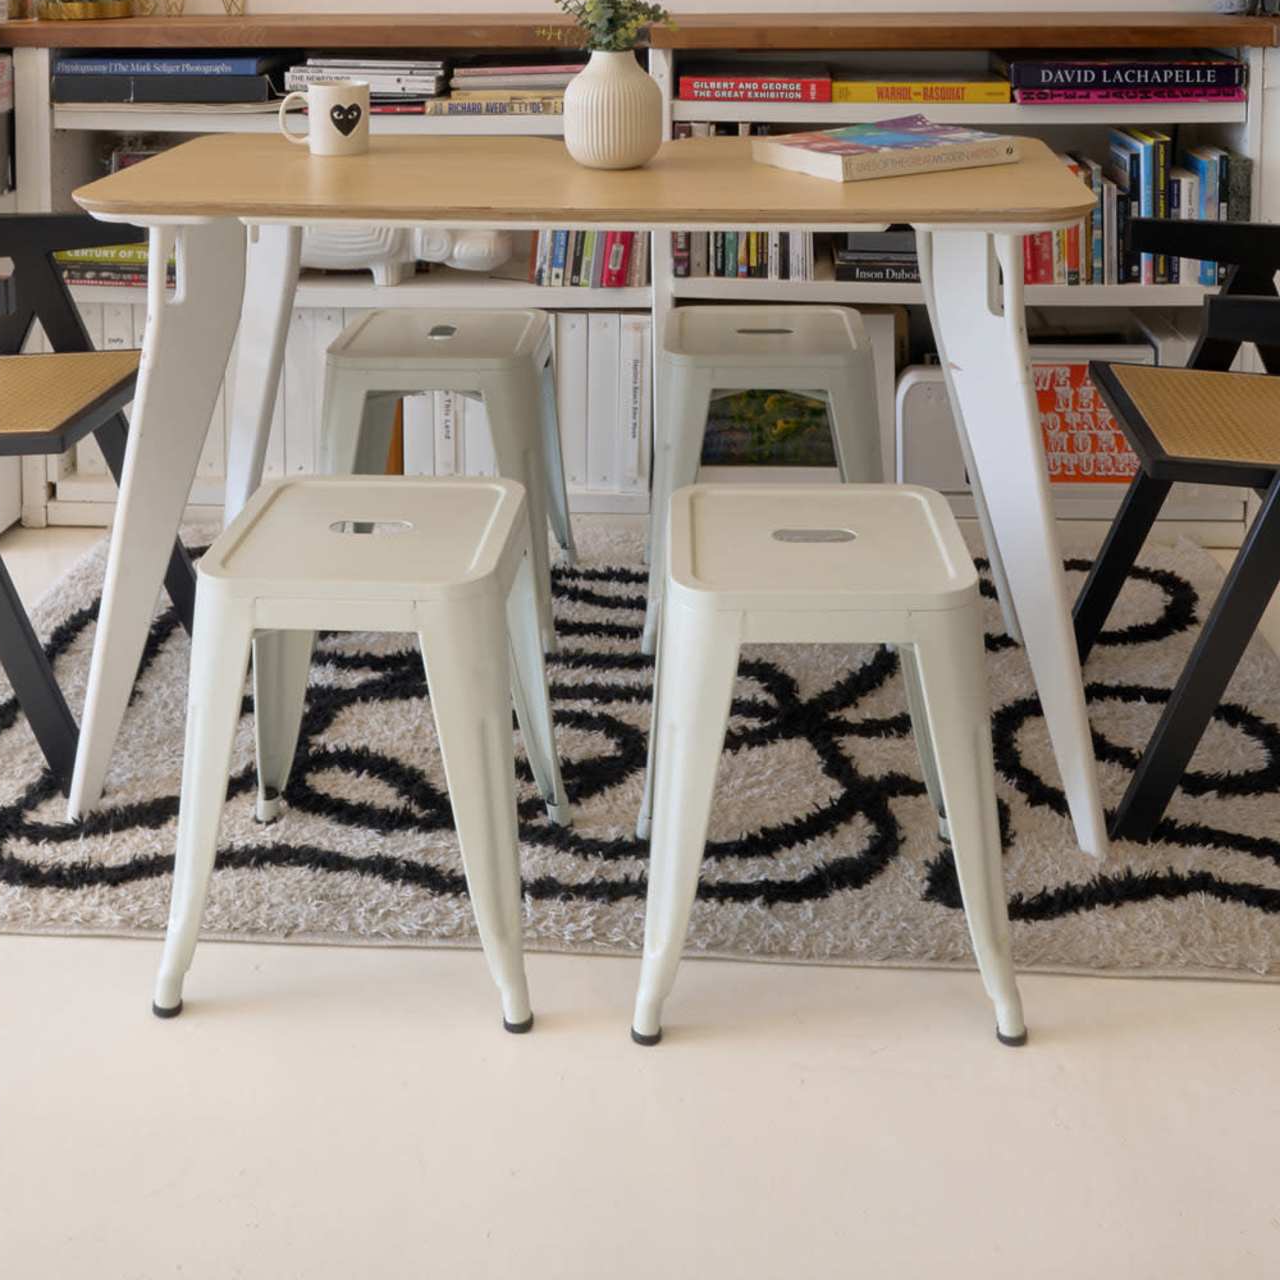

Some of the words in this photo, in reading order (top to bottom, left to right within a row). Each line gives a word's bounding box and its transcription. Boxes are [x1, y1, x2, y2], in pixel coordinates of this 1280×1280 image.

[130, 61, 151, 73] Mark
[181, 61, 232, 75] Photographs
[1040, 69, 1096, 83] DAVID
[1102, 69, 1217, 83] LACHAPELLE
[692, 81, 736, 89] GILBERT
[738, 82, 759, 90] AND
[761, 82, 801, 90] GEORGE
[714, 90, 745, 98] GREAT
[747, 91, 801, 99] EXHIBITION
[447, 102, 481, 114] RICHARD
[118, 250, 134, 258] OF
